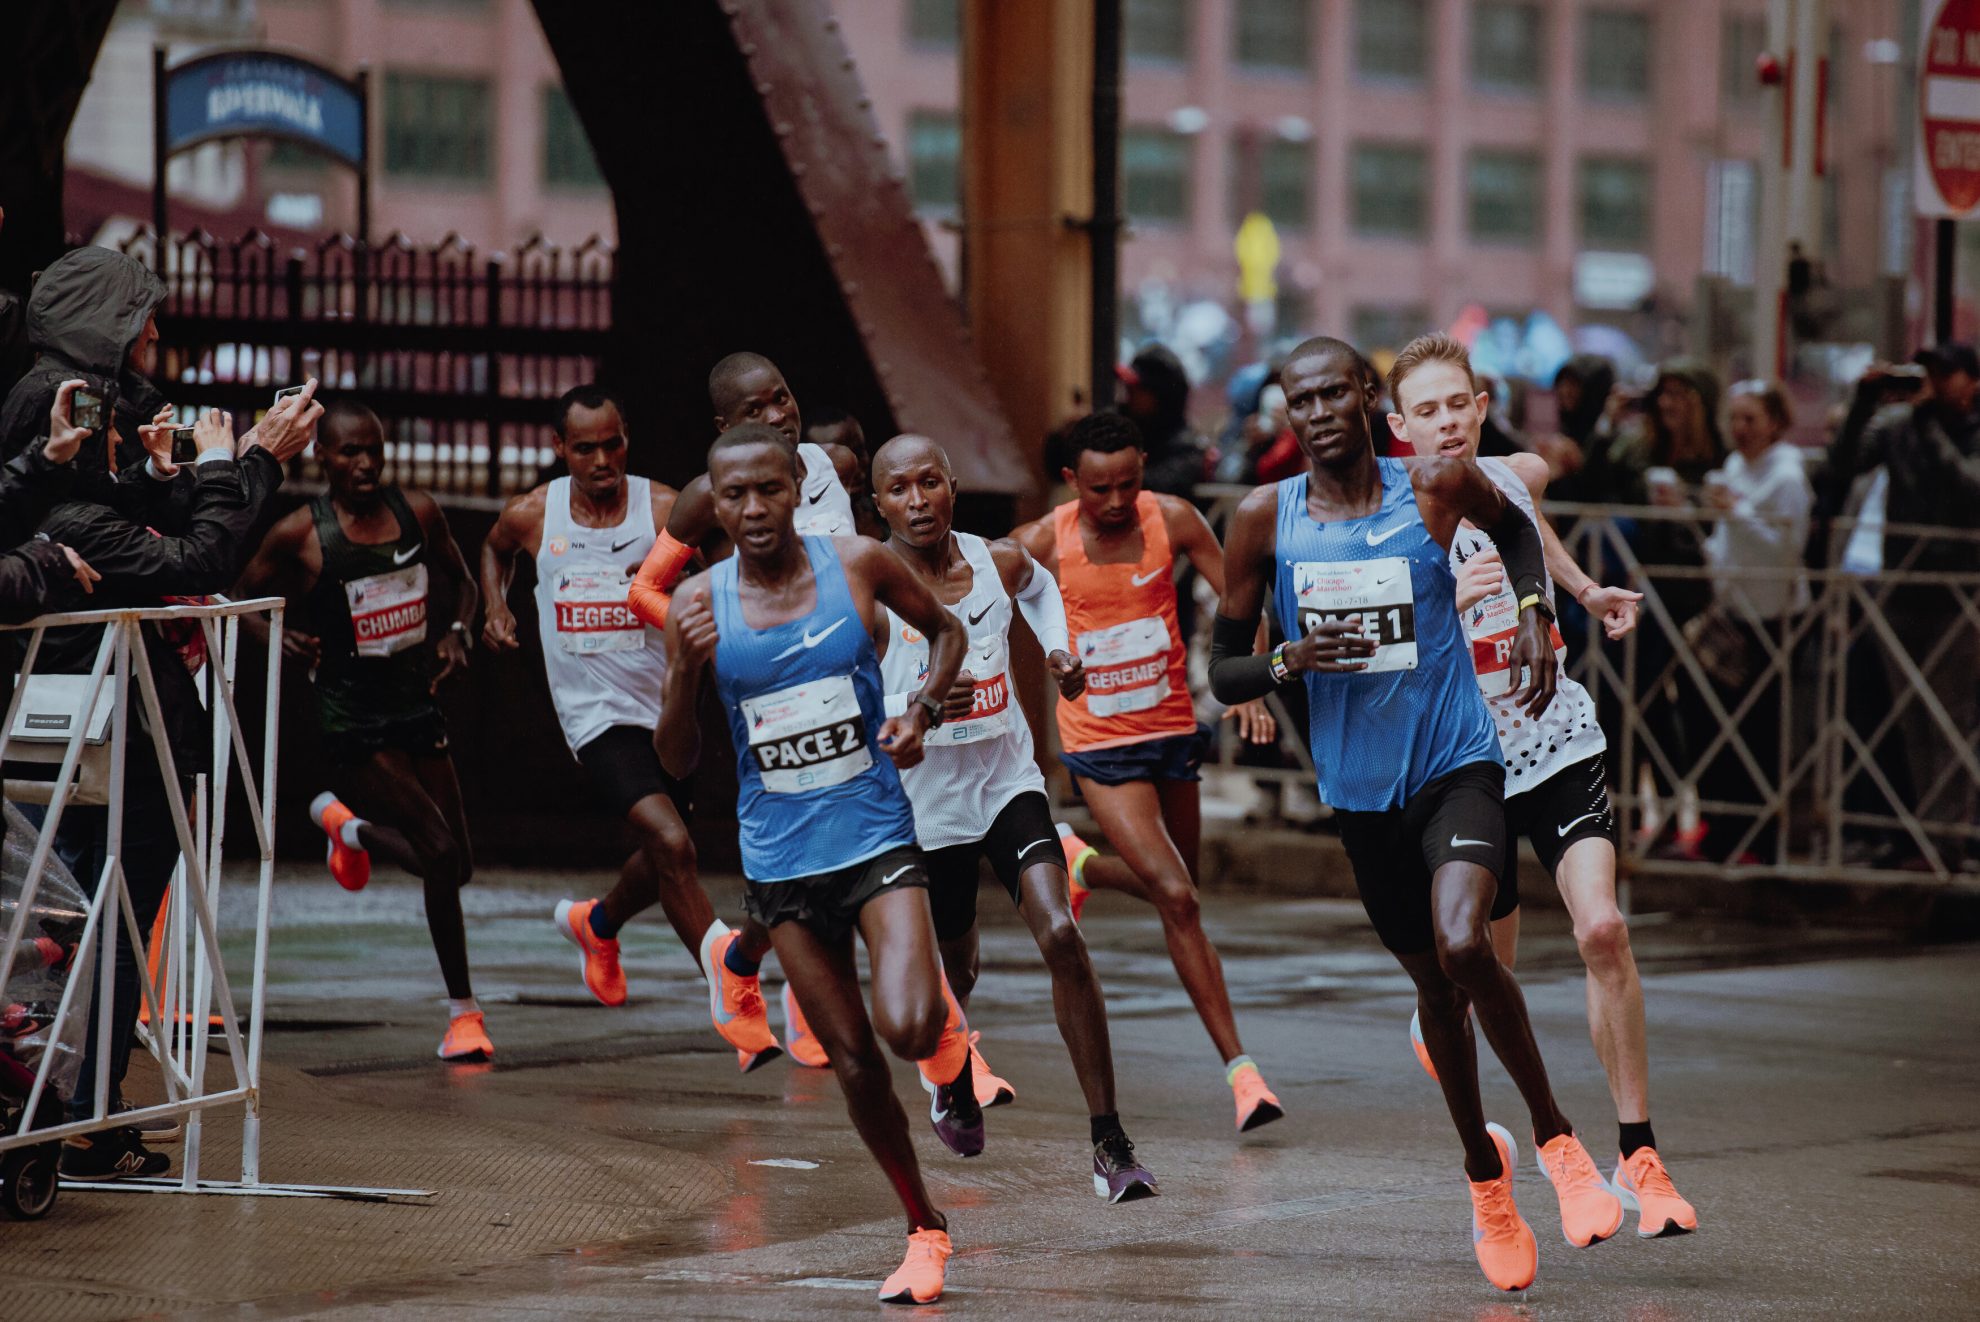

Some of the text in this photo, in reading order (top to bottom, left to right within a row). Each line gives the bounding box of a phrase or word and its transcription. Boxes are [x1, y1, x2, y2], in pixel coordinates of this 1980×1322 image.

[571, 541, 585, 549] NN
[1316, 577, 1345, 586] Chicago
[1316, 585, 1352, 593] Marathon
[1485, 601, 1507, 611] Chicago
[1487, 606, 1515, 618] Marathon
[356, 601, 426, 638] CHUMBA
[562, 606, 640, 628] LEGESE
[1387, 608, 1402, 640] 1
[972, 682, 1003, 712] RUI
[757, 723, 860, 769] PACE 2
